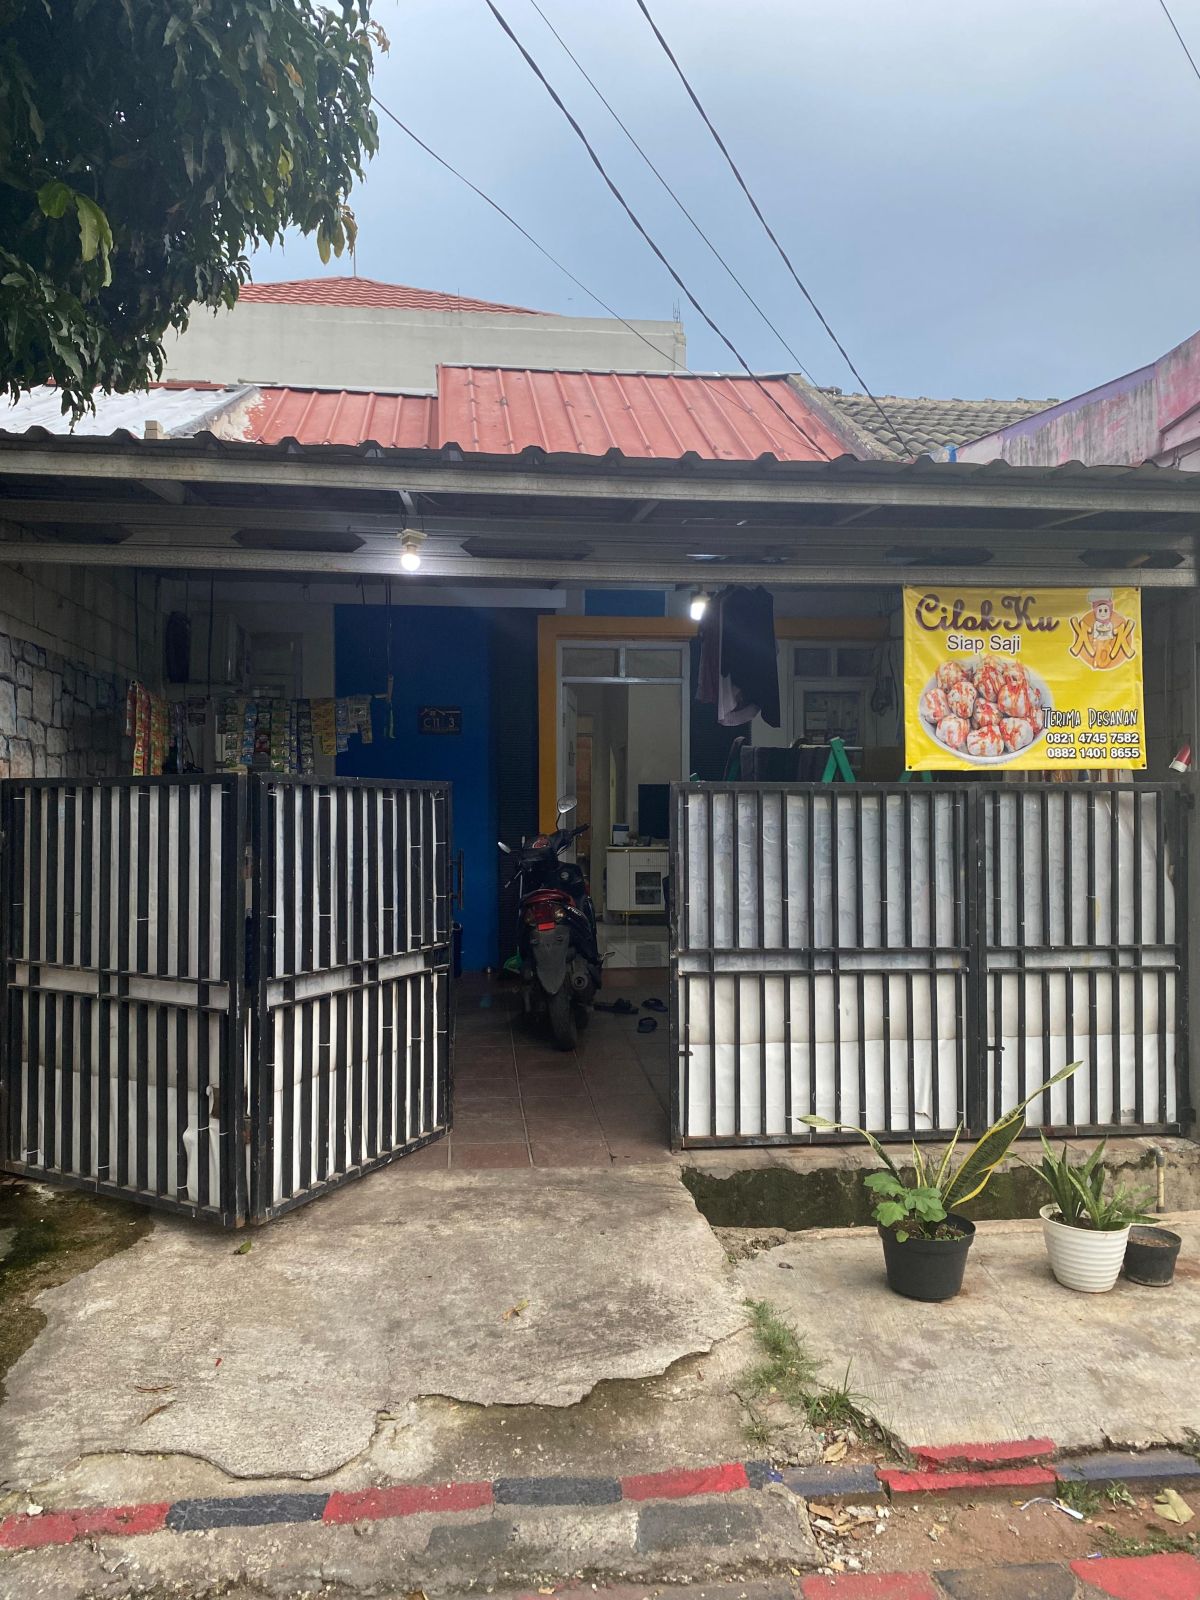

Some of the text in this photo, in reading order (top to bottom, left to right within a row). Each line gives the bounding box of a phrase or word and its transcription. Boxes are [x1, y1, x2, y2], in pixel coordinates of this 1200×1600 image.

[947, 635, 1020, 654] Siap Saji
[1046, 732, 1139, 744] 0821 4745 7582
[1047, 747, 1140, 759] 0882 1401 8655
